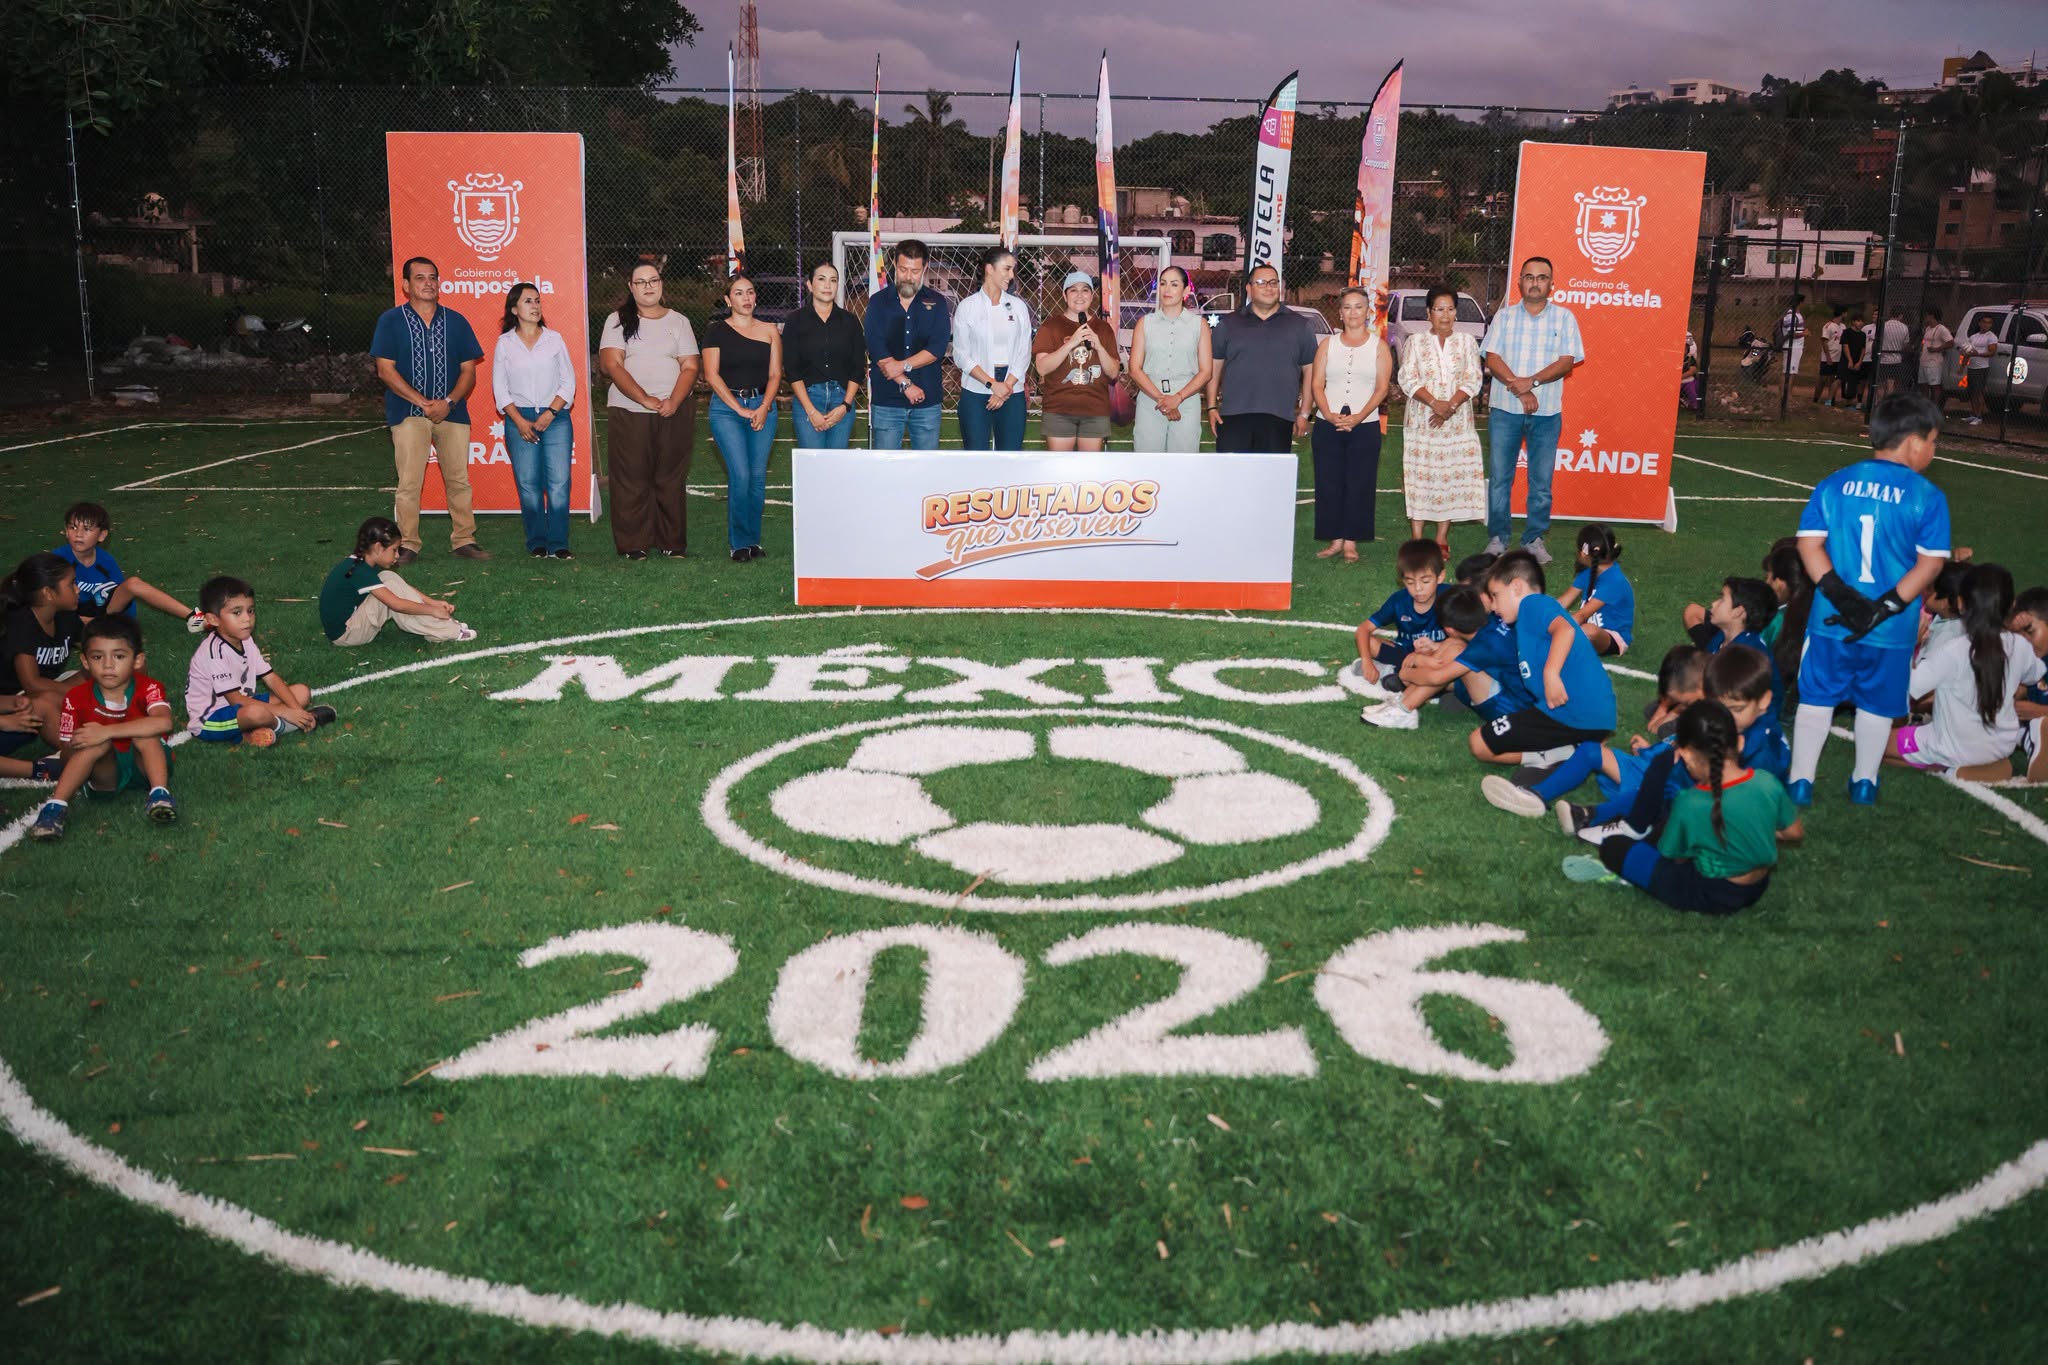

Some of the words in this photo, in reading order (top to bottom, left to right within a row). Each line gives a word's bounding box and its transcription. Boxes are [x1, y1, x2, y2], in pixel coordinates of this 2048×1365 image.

[454, 267, 501, 278] Gobierno
[504, 268, 518, 278] de
[1568, 278, 1614, 290] Gobierno
[1616, 281, 1630, 290] de
[438, 275, 555, 299] omposla
[1554, 448, 1660, 476] RANDE
[924, 482, 1157, 531] RESULTADOS
[1842, 481, 1905, 504] OLMAN
[948, 523, 1002, 560] que
[1043, 517, 1079, 537] se
[1082, 511, 1141, 536] ven
[1858, 514, 1876, 584] 1
[432, 921, 1608, 1085] 2026
